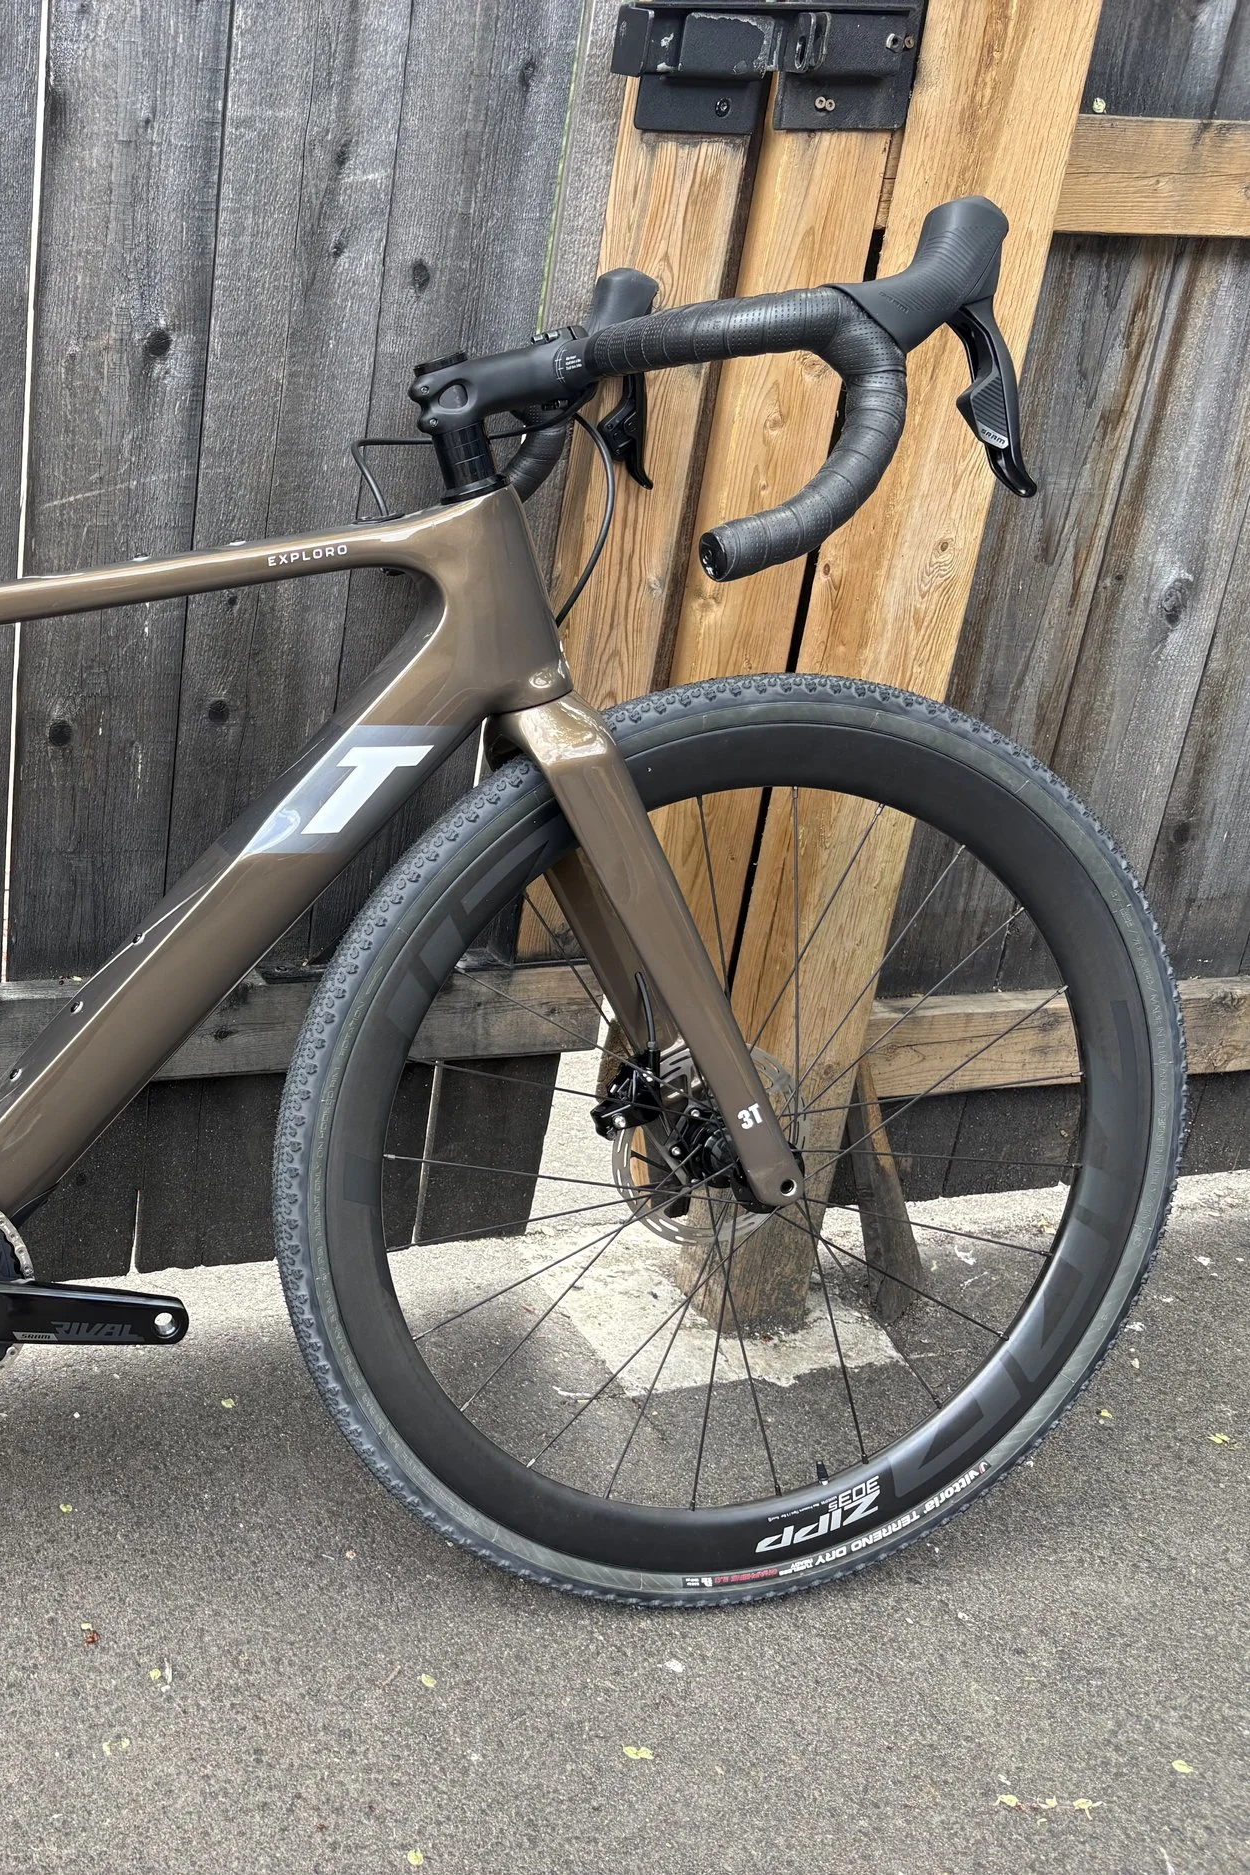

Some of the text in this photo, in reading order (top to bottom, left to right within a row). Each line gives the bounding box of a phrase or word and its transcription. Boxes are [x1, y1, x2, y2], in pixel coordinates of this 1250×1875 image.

[980, 428, 1006, 445] SRAM
[268, 544, 347, 567] EXPLORO
[737, 1103, 764, 1130] 3T
[316, 1140, 325, 1158] ON
[51, 1321, 139, 1339] RIVAL
[925, 1467, 986, 1513] vittoria
[755, 1490, 881, 1553] ZIPP
[851, 1511, 921, 1551] TERRENO
[814, 1546, 848, 1566] DRY
